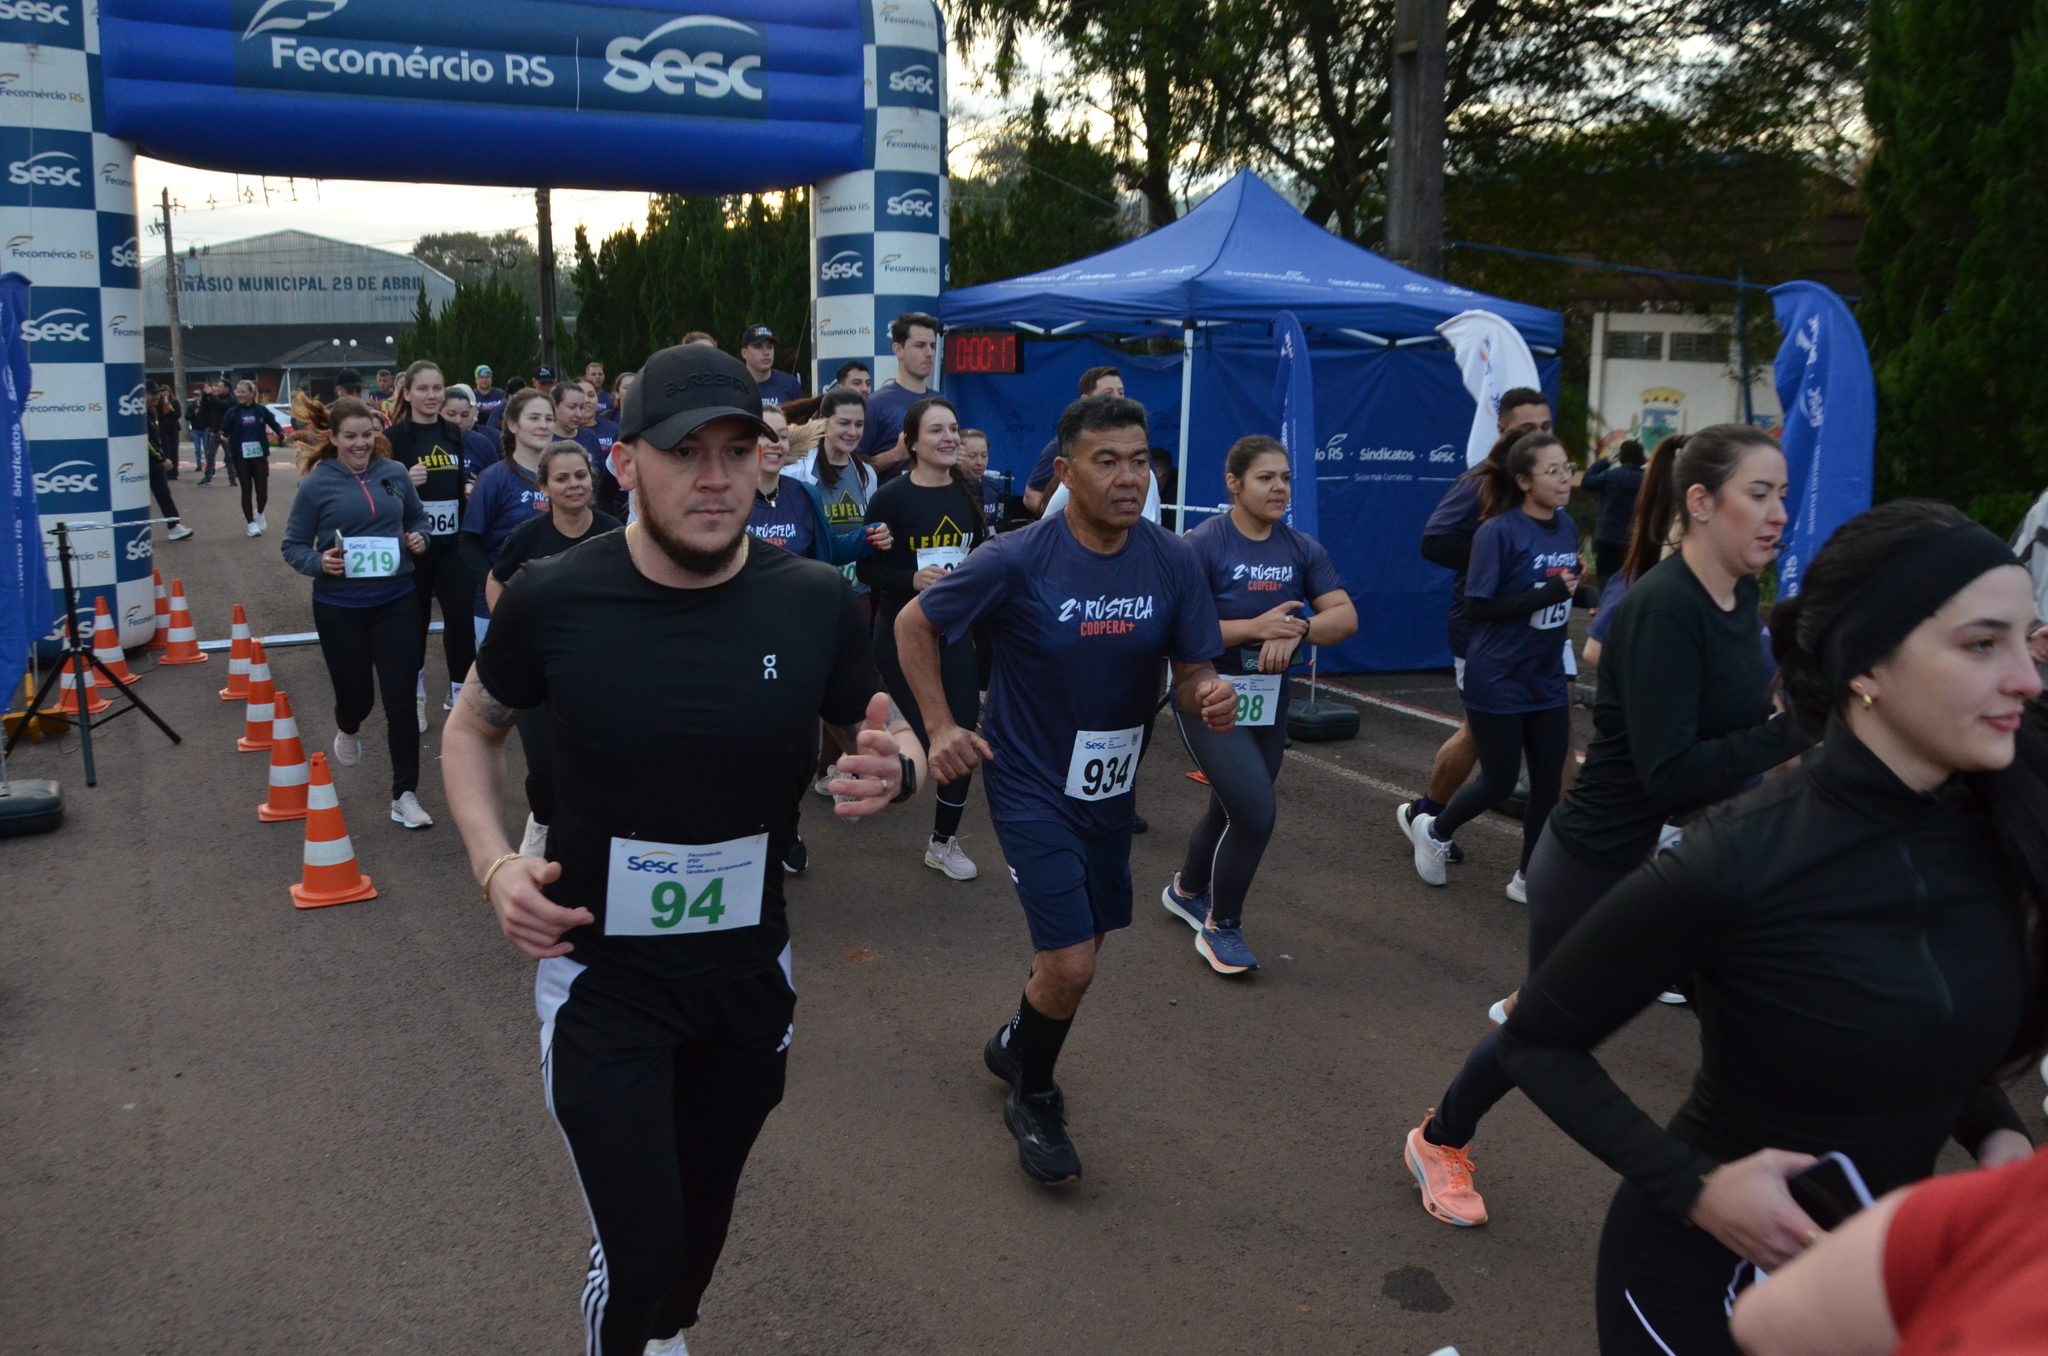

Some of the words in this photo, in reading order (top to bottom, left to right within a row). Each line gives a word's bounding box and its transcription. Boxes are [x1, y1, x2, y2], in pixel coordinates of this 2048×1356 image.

[270, 36, 494, 84] Fecomércio
[505, 54, 555, 88] RS
[603, 34, 762, 101] Sesc
[889, 70, 934, 95] Sesc
[69, 91, 85, 103] RS
[8, 161, 81, 187] Sesc
[886, 196, 933, 218] Sesc
[12, 248, 77, 261] Fecomércio
[80, 251, 94, 261] RS
[821, 261, 863, 279] Sesc
[239, 276, 326, 292] MUNICIPAL
[332, 276, 352, 292] 29
[358, 276, 377, 290] DE
[21, 319, 90, 342] Sesc
[89, 403, 103, 412] RS
[13, 423, 22, 498] Sindicatos
[1360, 447, 1416, 461] Sindicatos
[35, 472, 98, 494] Sesc
[97, 550, 110, 559] RS
[352, 551, 394, 573] 219
[1251, 563, 1293, 582] RÚSTICA
[1085, 595, 1153, 621] RÚSTICA
[1080, 619, 1135, 637] COOPERA+
[1236, 693, 1265, 722] 98
[1085, 741, 1106, 750] Sesc
[1081, 753, 1133, 796] 934
[627, 855, 679, 874] Sesc
[651, 877, 726, 928] 94
